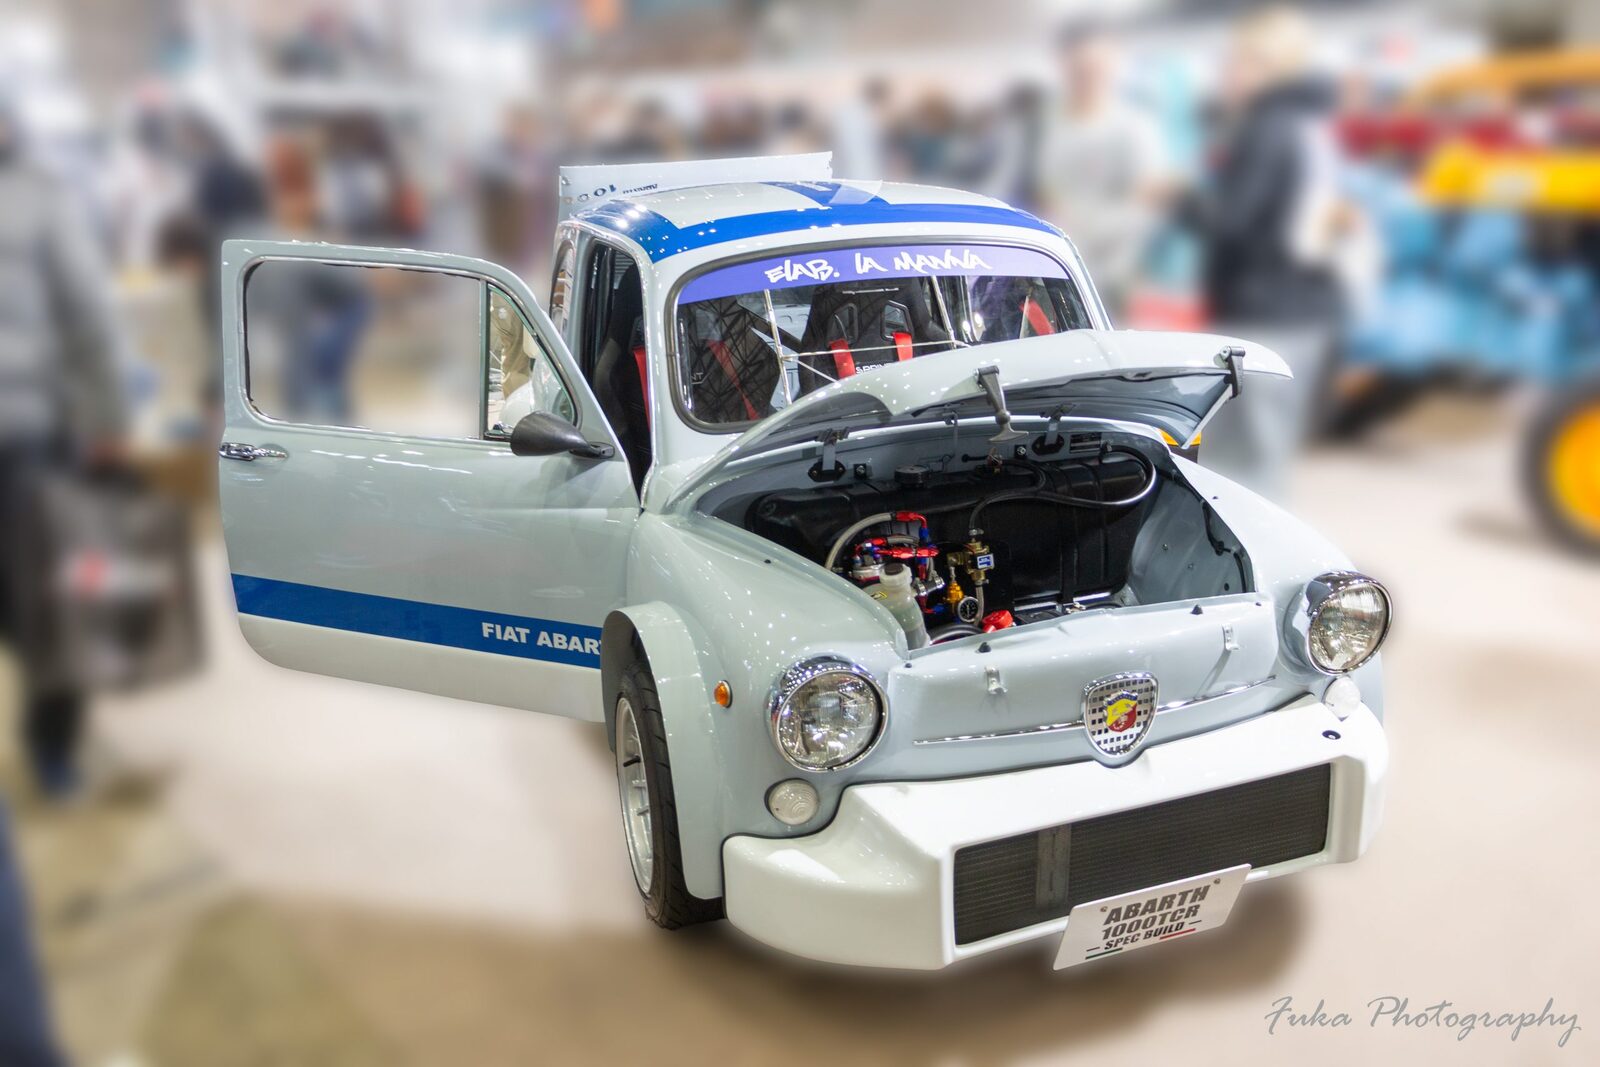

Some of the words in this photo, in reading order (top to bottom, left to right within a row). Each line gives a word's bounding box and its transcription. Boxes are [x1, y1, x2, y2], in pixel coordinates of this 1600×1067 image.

[893, 249, 992, 274] MANNA
[481, 622, 530, 643] FIAT
[536, 631, 602, 655] ABAR
[1103, 885, 1211, 926] ABARTH
[1102, 905, 1200, 940] 1000TCR
[1104, 934, 1140, 950] SPEC
[1143, 922, 1185, 941] BUILD
